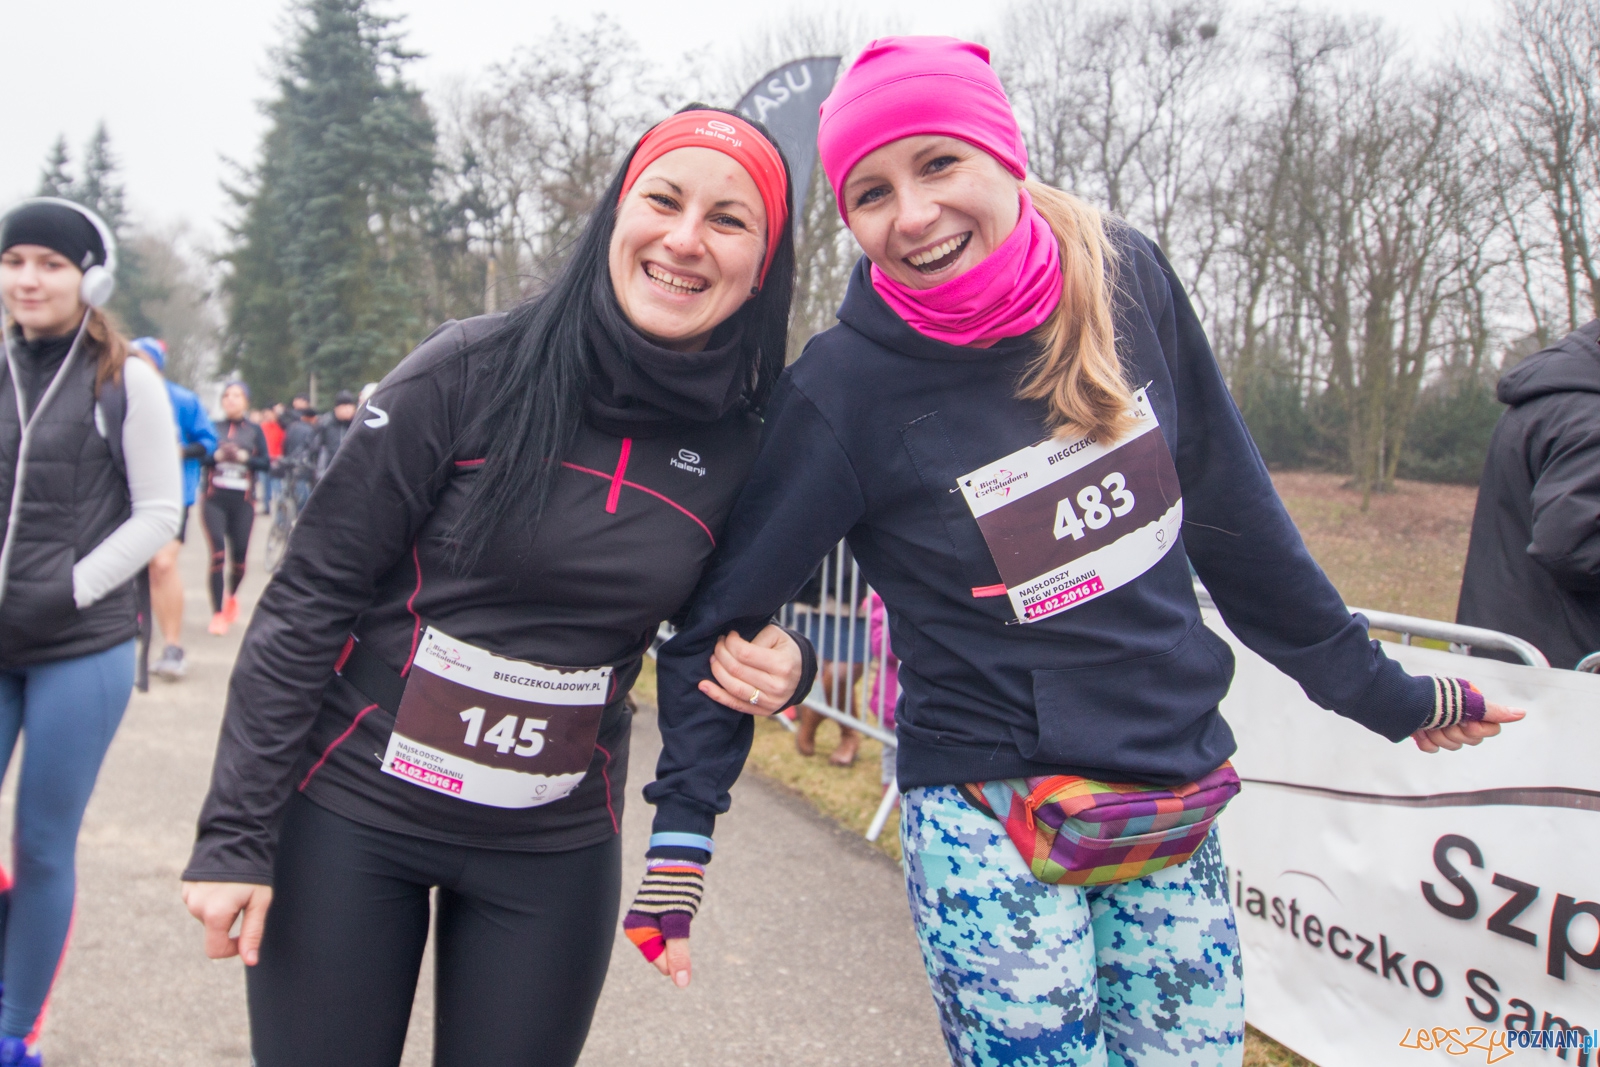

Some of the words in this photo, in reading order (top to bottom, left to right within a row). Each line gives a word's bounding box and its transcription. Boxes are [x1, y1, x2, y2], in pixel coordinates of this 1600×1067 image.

[742, 64, 812, 122] ASU
[694, 127, 742, 147] Kalenji
[670, 457, 706, 477] Kalenji
[975, 471, 1029, 498] Czekoladowy
[980, 478, 998, 489] Bieg
[1053, 472, 1135, 541] 483
[1019, 570, 1070, 597] NAJSŁODSZY
[1022, 593, 1042, 606] BIEG
[1043, 590, 1052, 598] W
[1053, 569, 1097, 593] POZNANIU
[1027, 584, 1091, 617] 14.02.2016
[1091, 581, 1103, 592] r.
[493, 671, 601, 691] BIEGCZEKOLADOWY.PL
[459, 706, 548, 758] 145
[395, 750, 412, 762] BIEG
[413, 757, 421, 765] W
[422, 762, 464, 779] POZNANIU
[397, 742, 445, 763] NAJSŁODSZY
[394, 760, 452, 789] 14.02.2016
[451, 782, 461, 792] r.
[1225, 865, 1444, 998] iasteczko
[1465, 968, 1600, 1067] Sam
